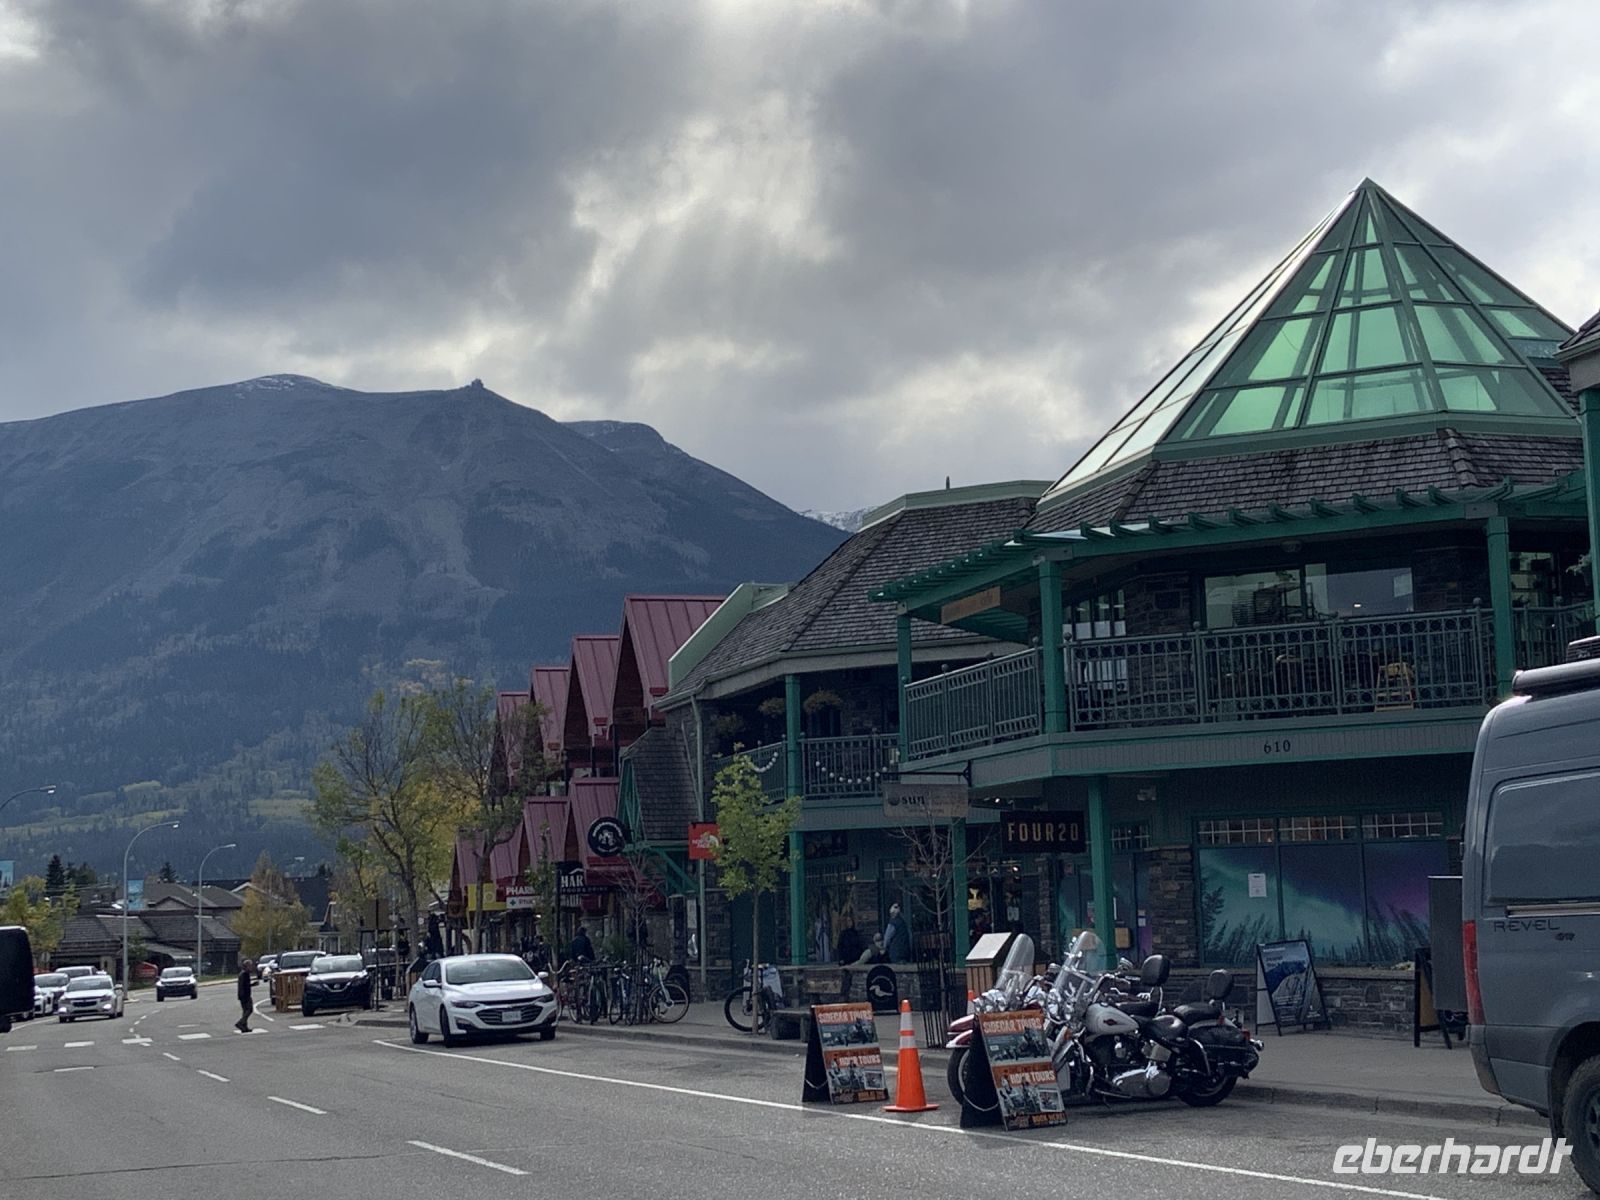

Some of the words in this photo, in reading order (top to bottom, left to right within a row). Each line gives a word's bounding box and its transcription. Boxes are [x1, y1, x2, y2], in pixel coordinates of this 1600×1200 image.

[1263, 739, 1291, 754] 610
[1007, 821, 1079, 842] FOUR20
[1493, 919, 1561, 932] REVEL
[818, 1011, 849, 1024] SIDECAR
[848, 1010, 873, 1024] TOURS
[983, 1019, 1016, 1034] SIDECAR
[1014, 1017, 1042, 1033] TOURS
[858, 1054, 881, 1065] TOURS
[1030, 1070, 1056, 1082] TOURS
